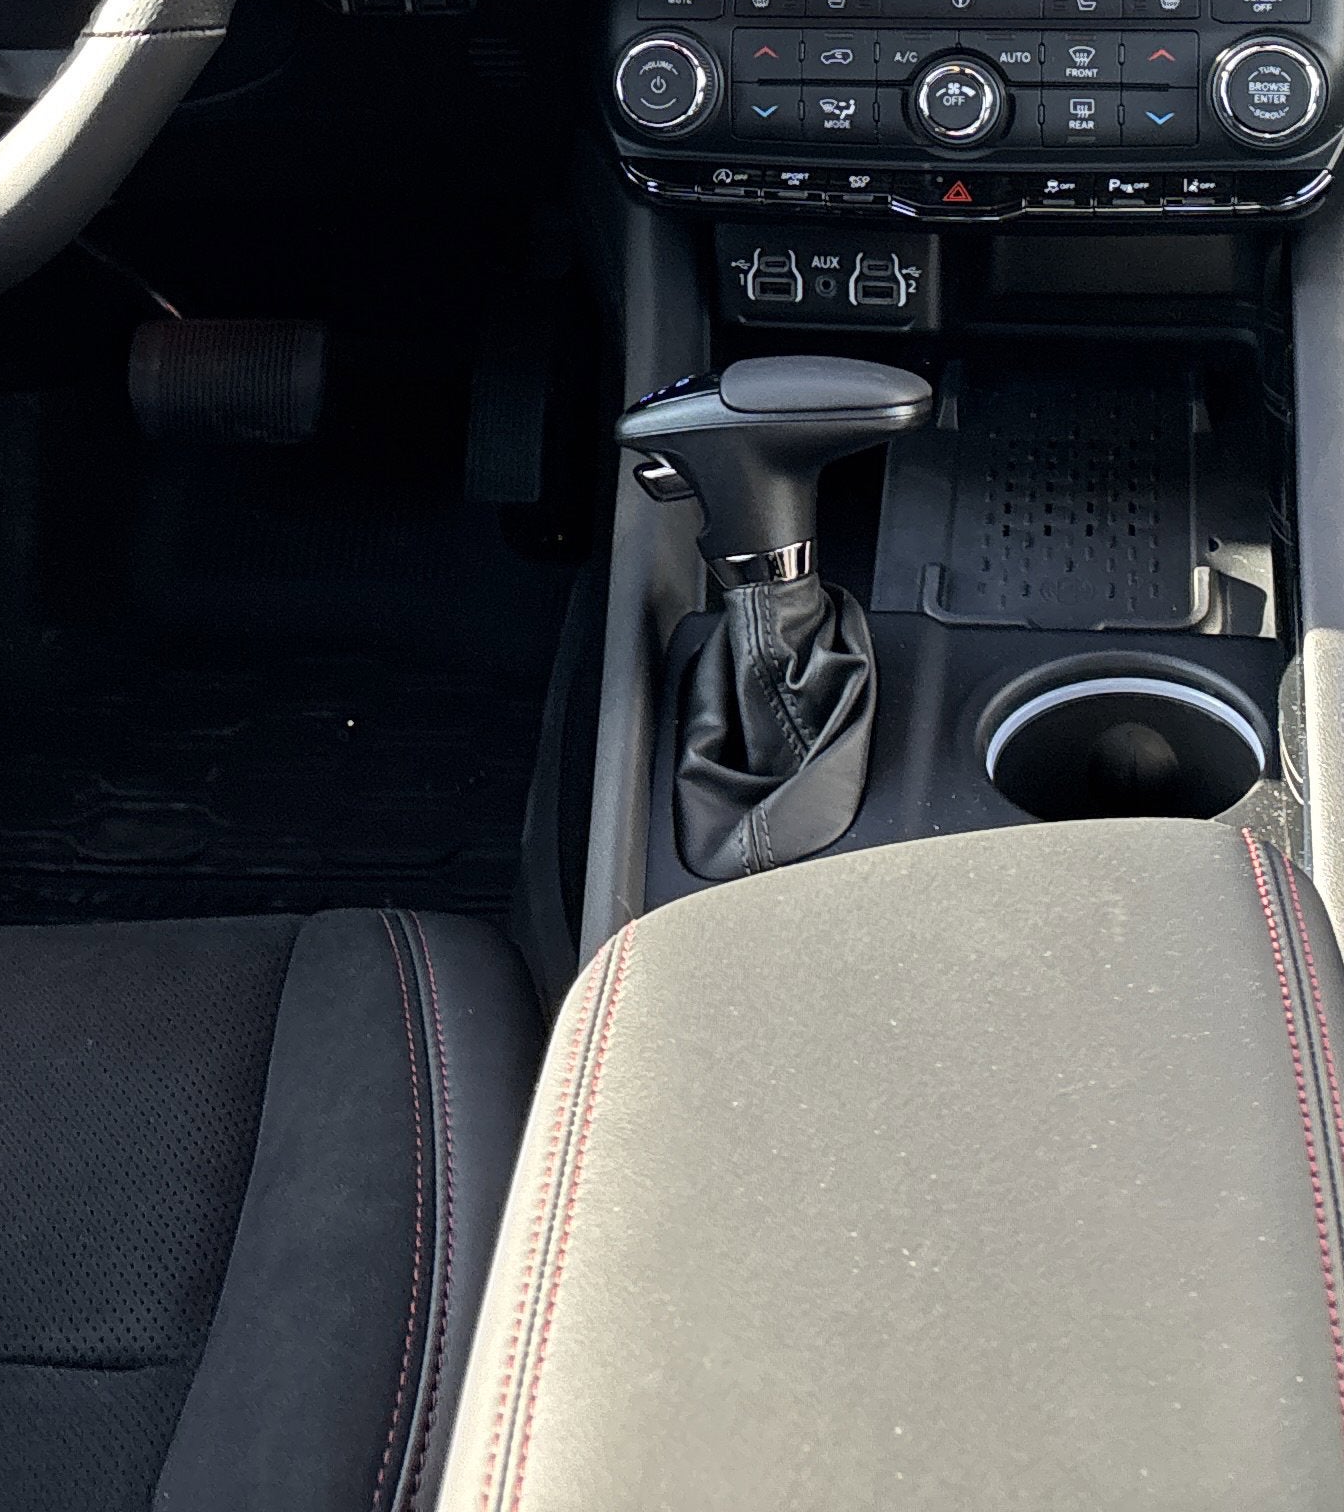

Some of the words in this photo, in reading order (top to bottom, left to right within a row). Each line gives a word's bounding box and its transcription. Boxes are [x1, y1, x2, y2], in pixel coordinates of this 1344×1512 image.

[1252, 3, 1273, 13] OFF
[894, 50, 919, 64] A/C
[999, 51, 1032, 64] AUTO
[1065, 67, 1099, 79] FRONT
[1258, 65, 1282, 76] TUNE
[1248, 81, 1291, 92] BROWSE
[942, 94, 966, 107] OFF
[1253, 93, 1287, 105] ENTER
[1252, 107, 1286, 120] SCROLL
[823, 119, 852, 130] MODE
[1068, 119, 1095, 131] REAR
[780, 172, 809, 180] SPORT
[1059, 181, 1076, 190] OFF
[1134, 181, 1150, 190] OFF
[1199, 182, 1216, 190] OFF
[811, 255, 841, 270] AUX
[739, 274, 745, 286] 1
[907, 280, 917, 293] 2
